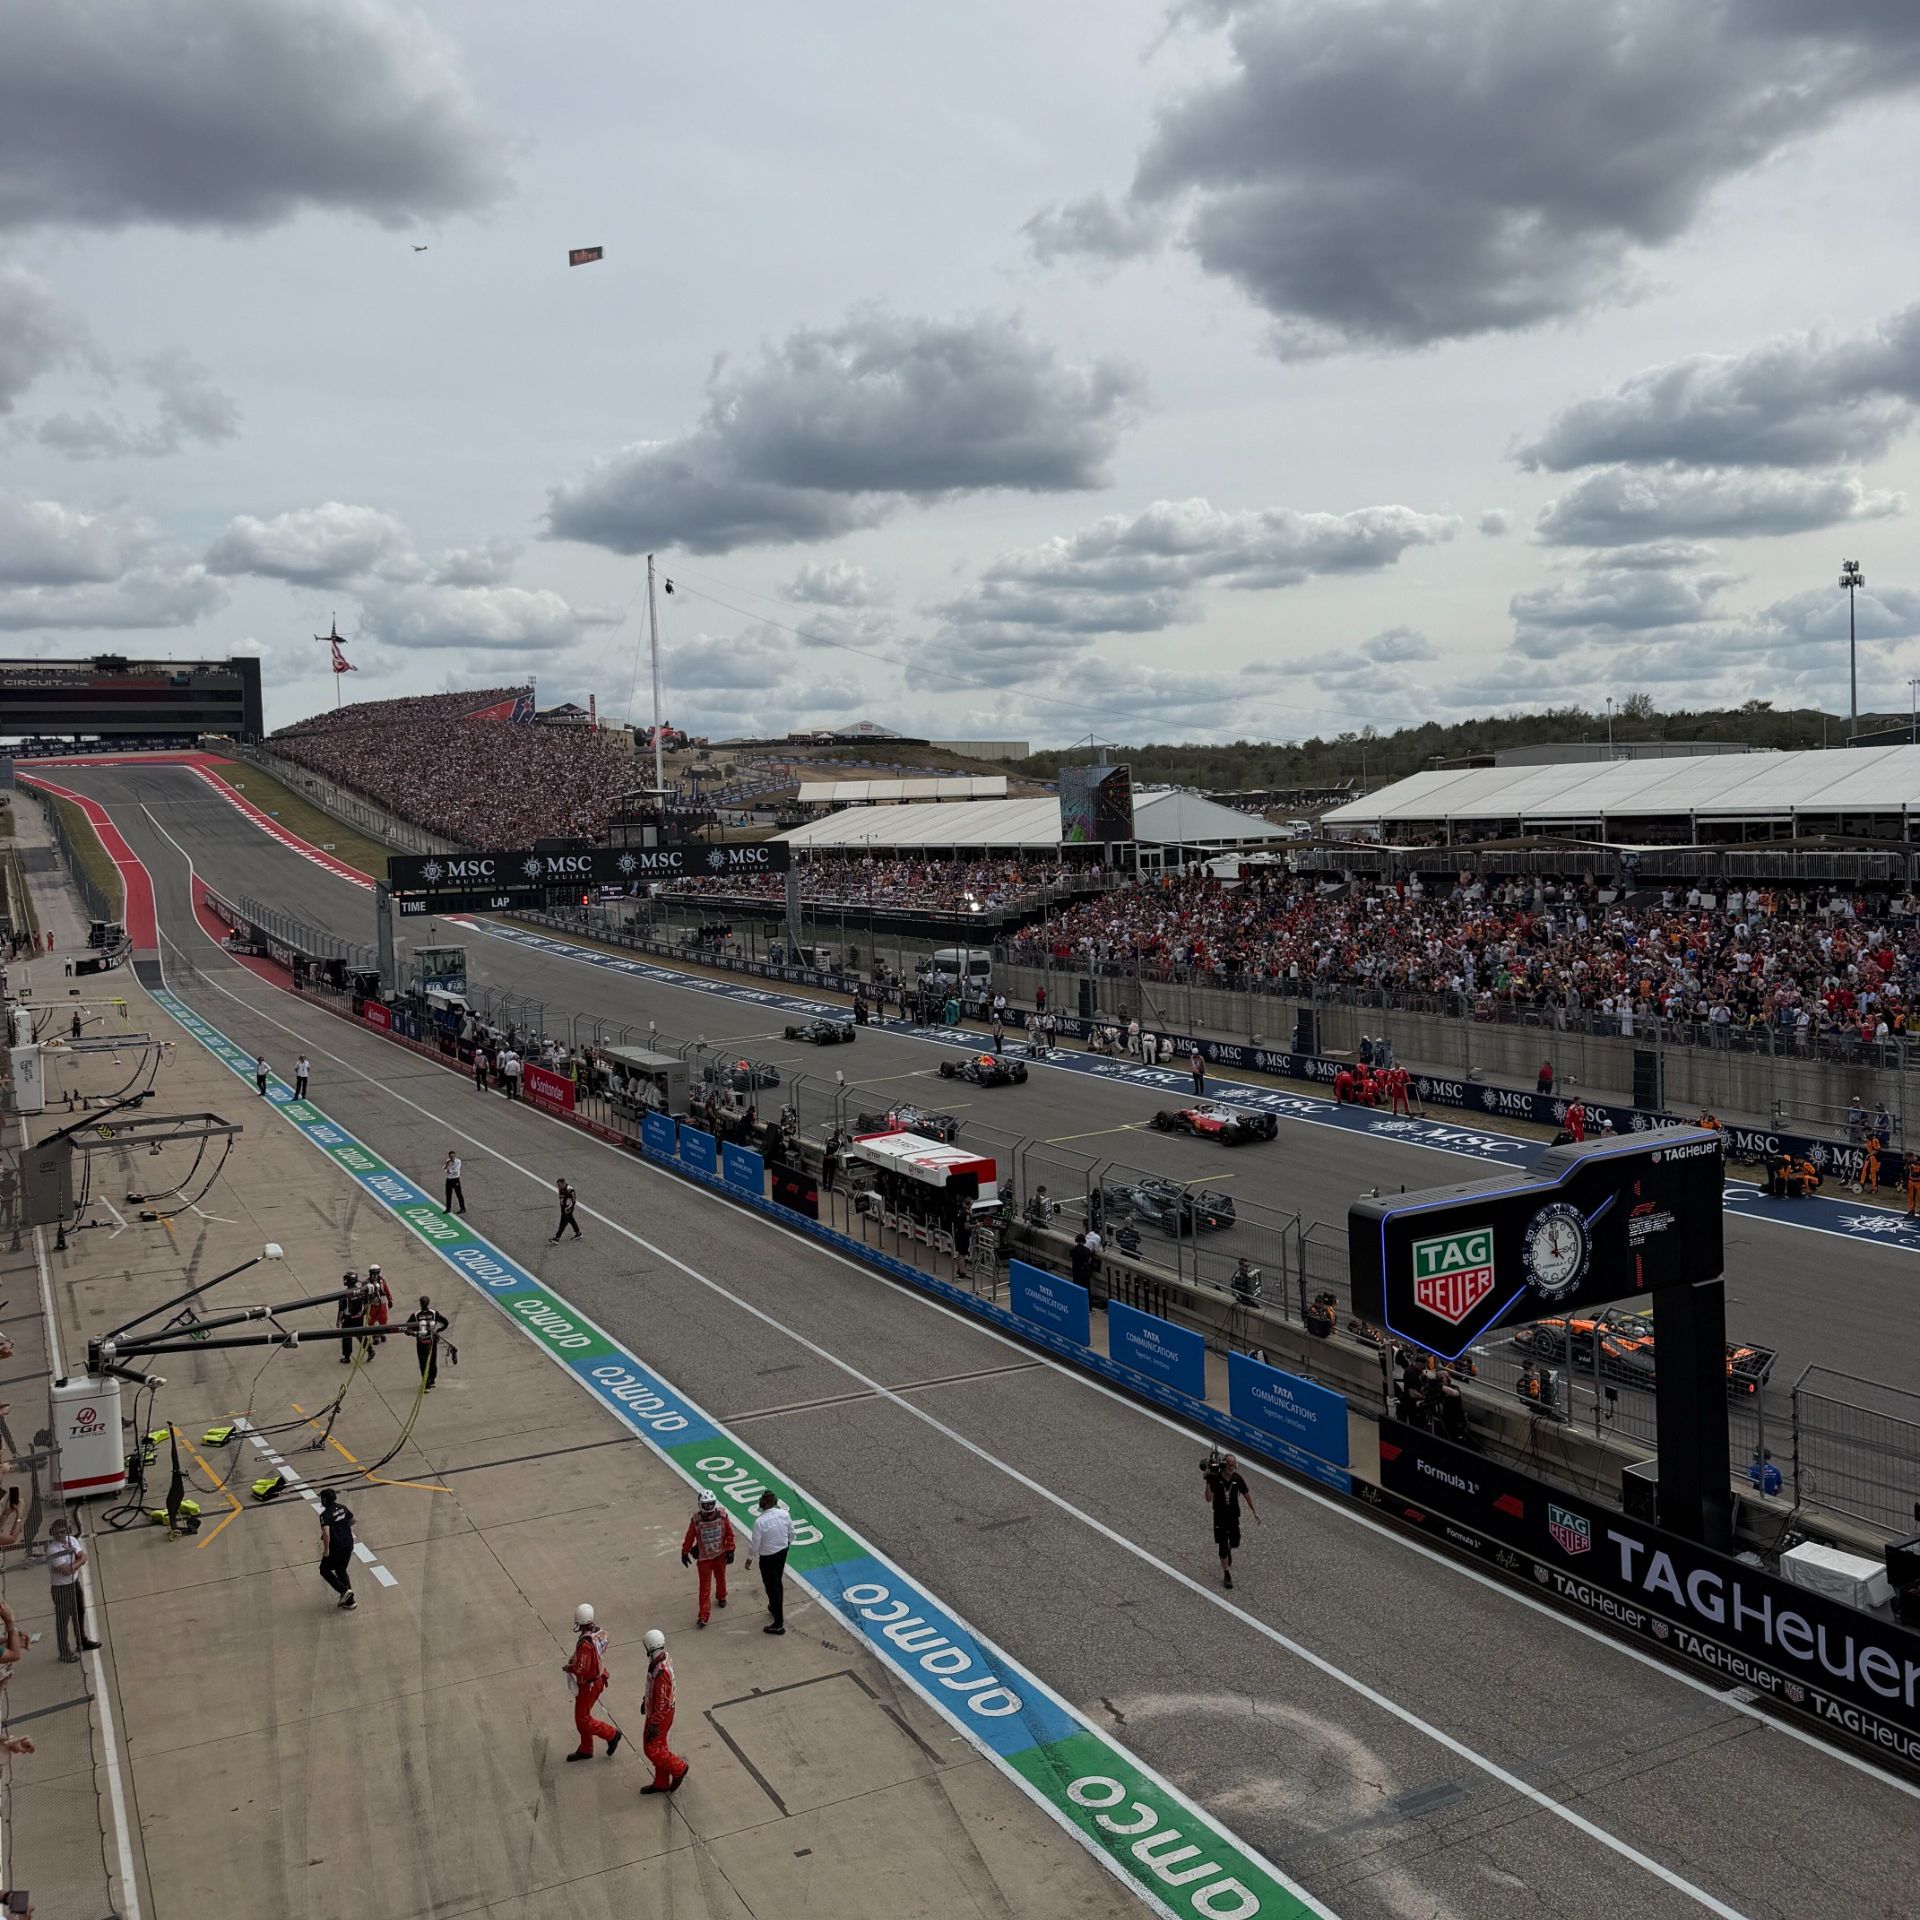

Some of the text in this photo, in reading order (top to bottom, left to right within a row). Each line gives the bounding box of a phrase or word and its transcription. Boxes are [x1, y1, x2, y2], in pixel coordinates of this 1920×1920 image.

[547, 856, 592, 873] MSC
[640, 852, 682, 868] MSC
[728, 848, 768, 864] MSC
[448, 860, 495, 878] MSC
[401, 902, 426, 912] TIME
[492, 897, 510, 908] LAP
[1064, 1020, 1081, 1032] MSC
[1220, 1046, 1241, 1059] MSC
[1267, 1054, 1290, 1068] MSC
[1126, 1069, 1194, 1083] MSC
[1317, 1062, 1342, 1076] MSC
[536, 1077, 563, 1101] Santander
[1432, 1080, 1463, 1098] MSC
[1248, 1094, 1340, 1112] MSC
[1500, 1092, 1532, 1111] MSC
[1584, 1106, 1606, 1124] SC
[1412, 1128, 1527, 1152] MSC
[1736, 1131, 1779, 1153] MSC
[1664, 1142, 1718, 1161] TAGHeuer
[1832, 1148, 1864, 1169] MS
[405, 1208, 460, 1239] aramco
[1420, 1236, 1487, 1272] TAG
[453, 1249, 518, 1287] aramco
[1025, 1287, 1069, 1314] COMMUNICATIONS
[1039, 1285, 1053, 1298] TATA
[1420, 1270, 1490, 1318] HEUER
[513, 1299, 592, 1348] aramco
[1143, 1329, 1160, 1343] TATA
[1126, 1332, 1178, 1361] COMMUNICATIONS
[591, 1366, 688, 1431] aramco
[1272, 1384, 1294, 1400] TATA
[1251, 1386, 1317, 1422] COMMUNICATIONS
[70, 1423, 105, 1434] TGR
[1417, 1459, 1466, 1490] Formula
[1551, 1507, 1587, 1534] TAG
[1447, 1527, 1468, 1546] Formula
[1551, 1525, 1589, 1553] HEUER
[1553, 1573, 1646, 1628] TAGHeuer
[1607, 1529, 1920, 1708] TAGHeuer
[842, 1583, 1024, 1717] aramco
[1674, 1629, 1782, 1692] TAGHeuer
